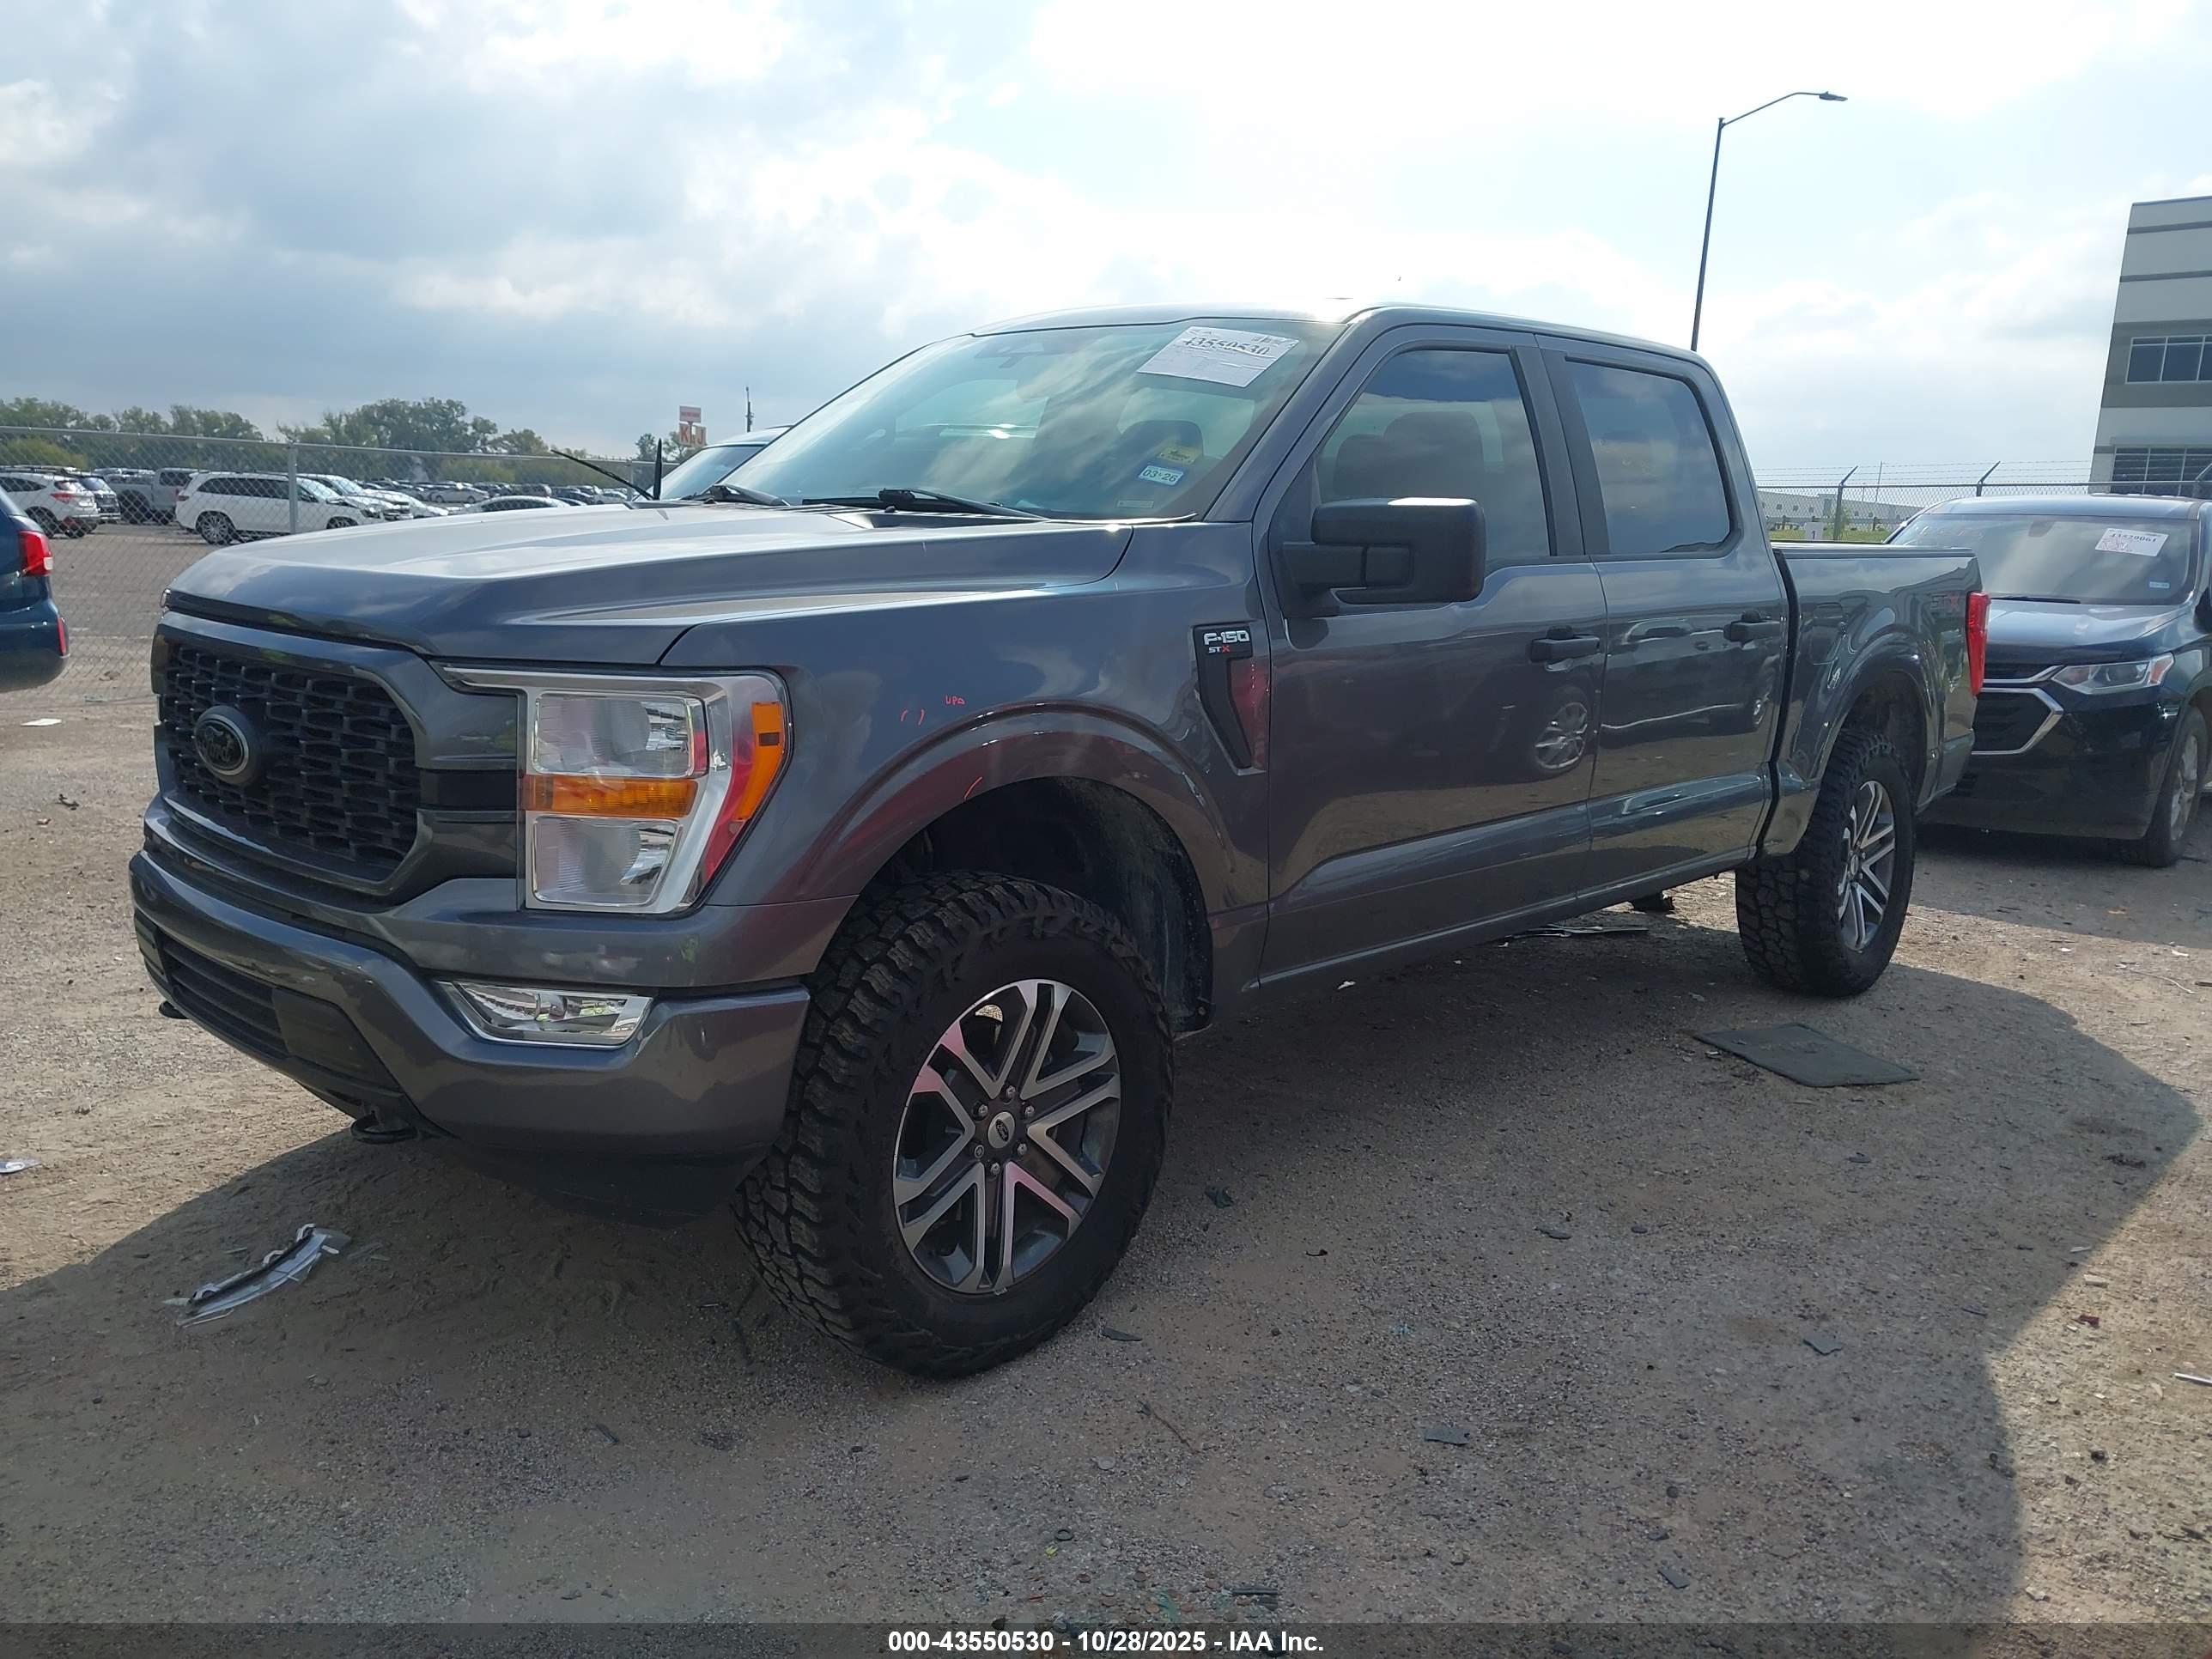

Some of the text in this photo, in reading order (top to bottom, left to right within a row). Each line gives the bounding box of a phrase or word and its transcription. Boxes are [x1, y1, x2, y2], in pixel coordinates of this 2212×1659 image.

[1203, 629, 1250, 646] F-150
[1208, 645, 1231, 653] STX
[203, 726, 234, 763] Ford
